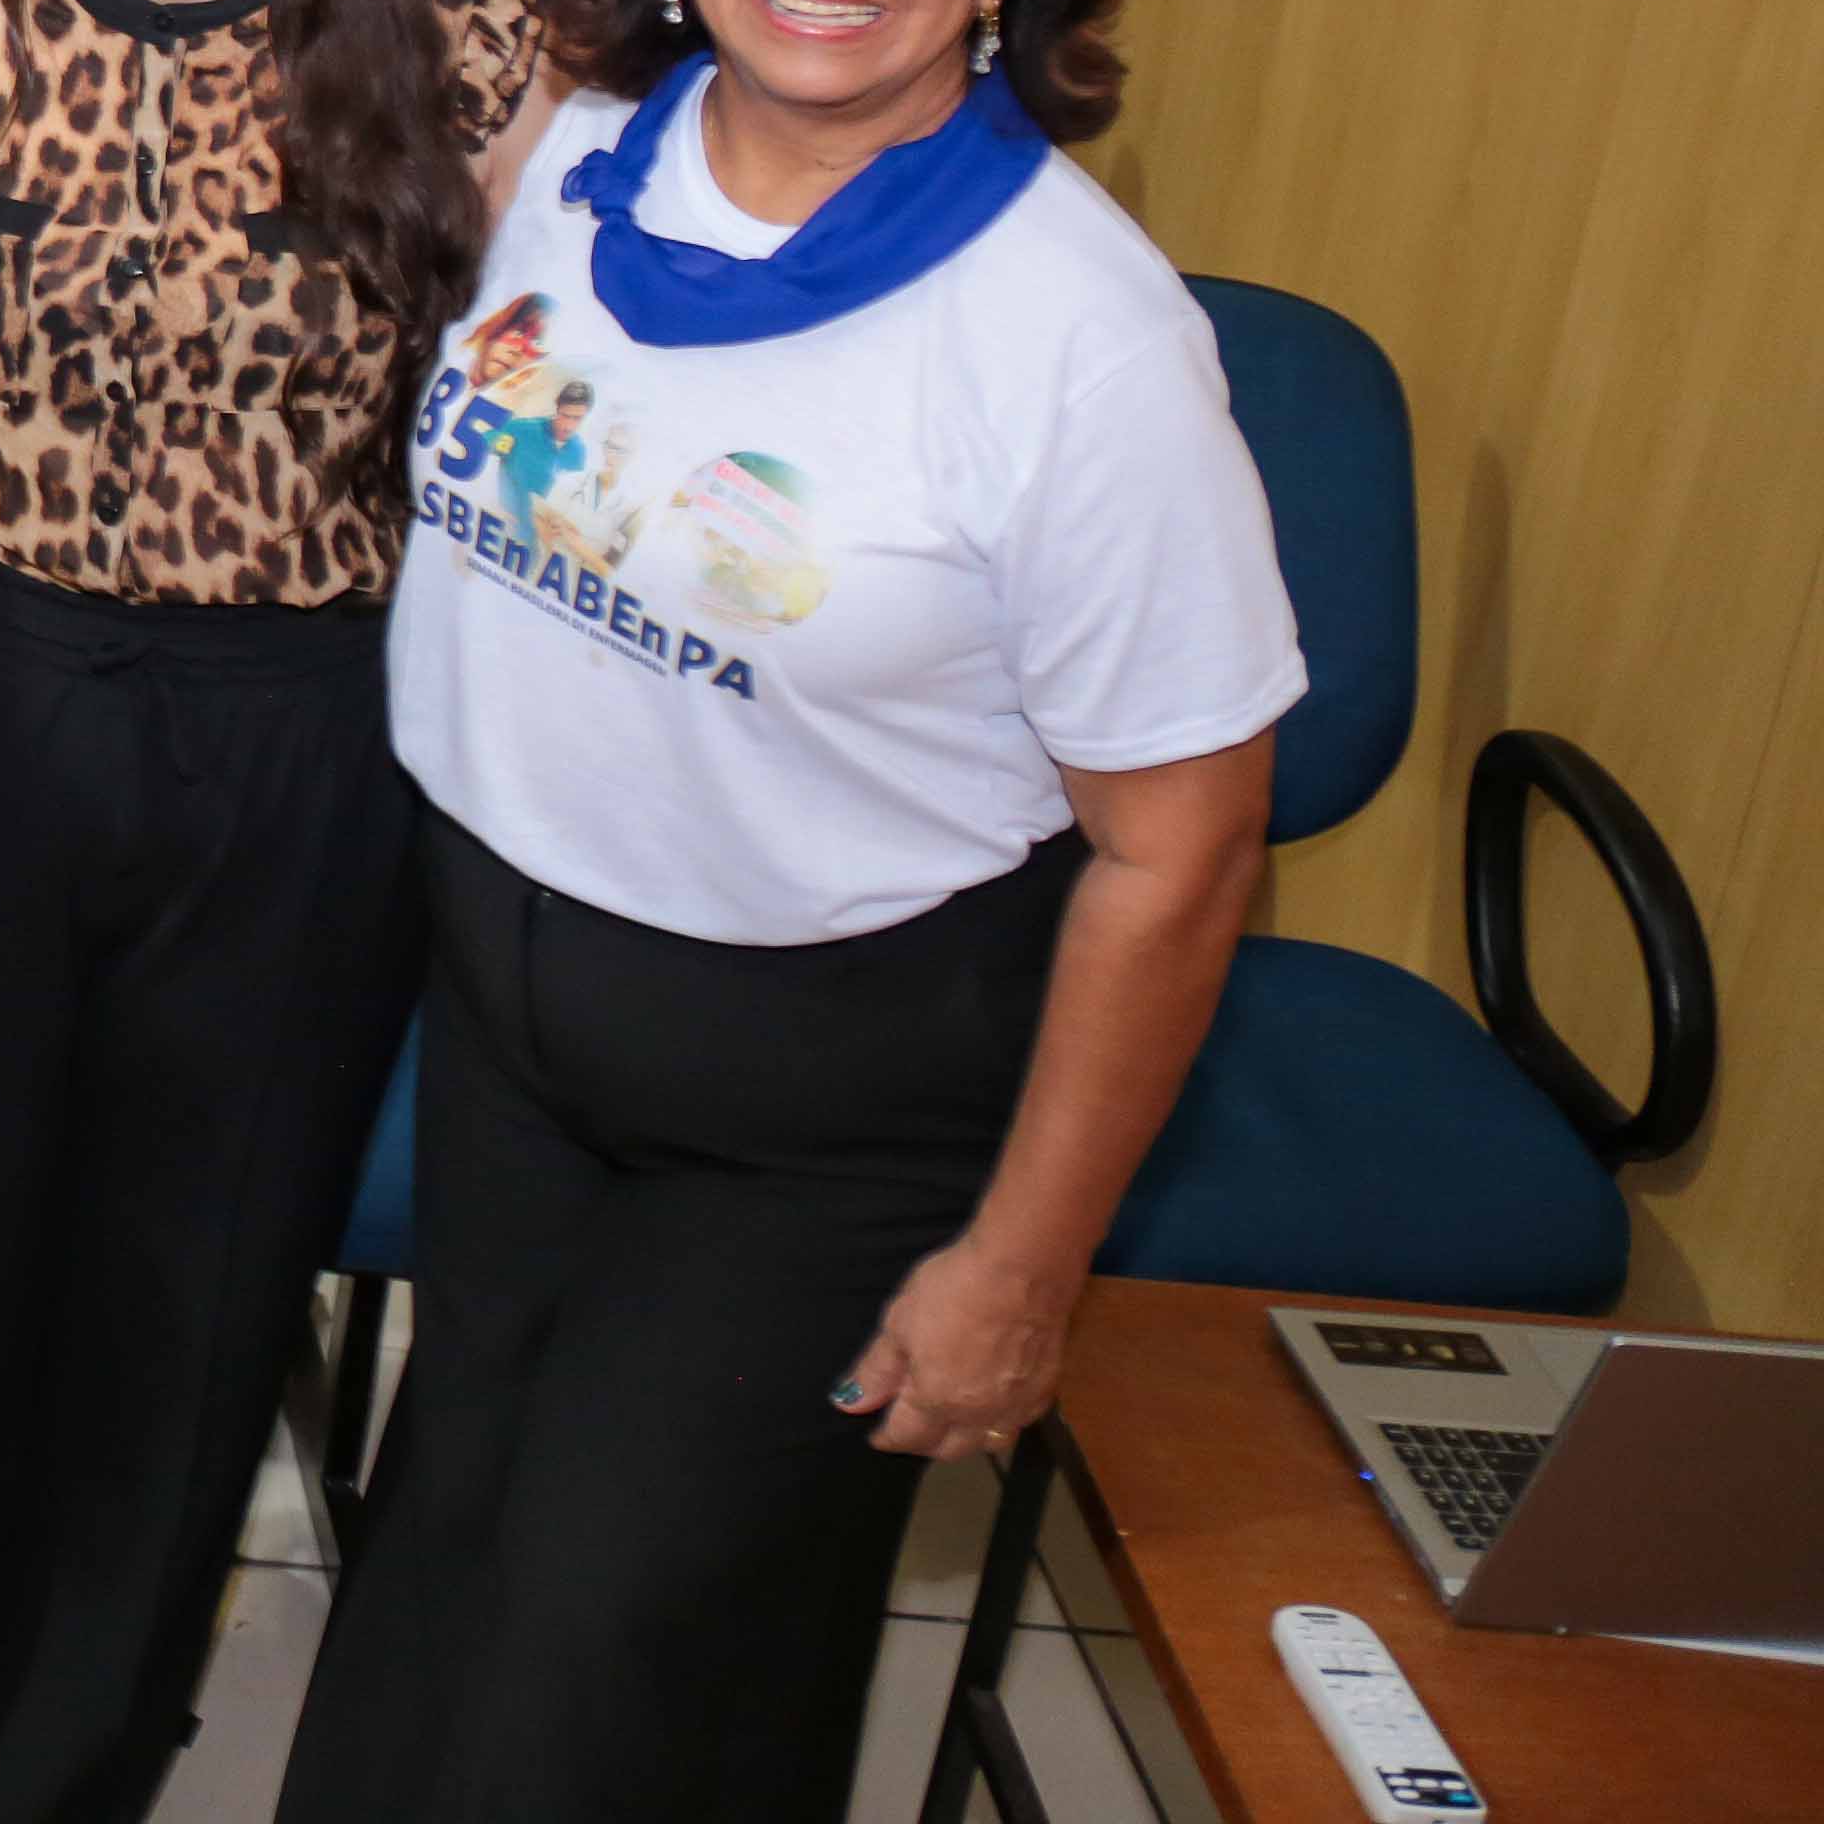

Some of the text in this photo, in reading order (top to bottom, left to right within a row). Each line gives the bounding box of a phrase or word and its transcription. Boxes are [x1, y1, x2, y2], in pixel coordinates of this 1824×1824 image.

[417, 480, 757, 701] SBEn ABEn PA
